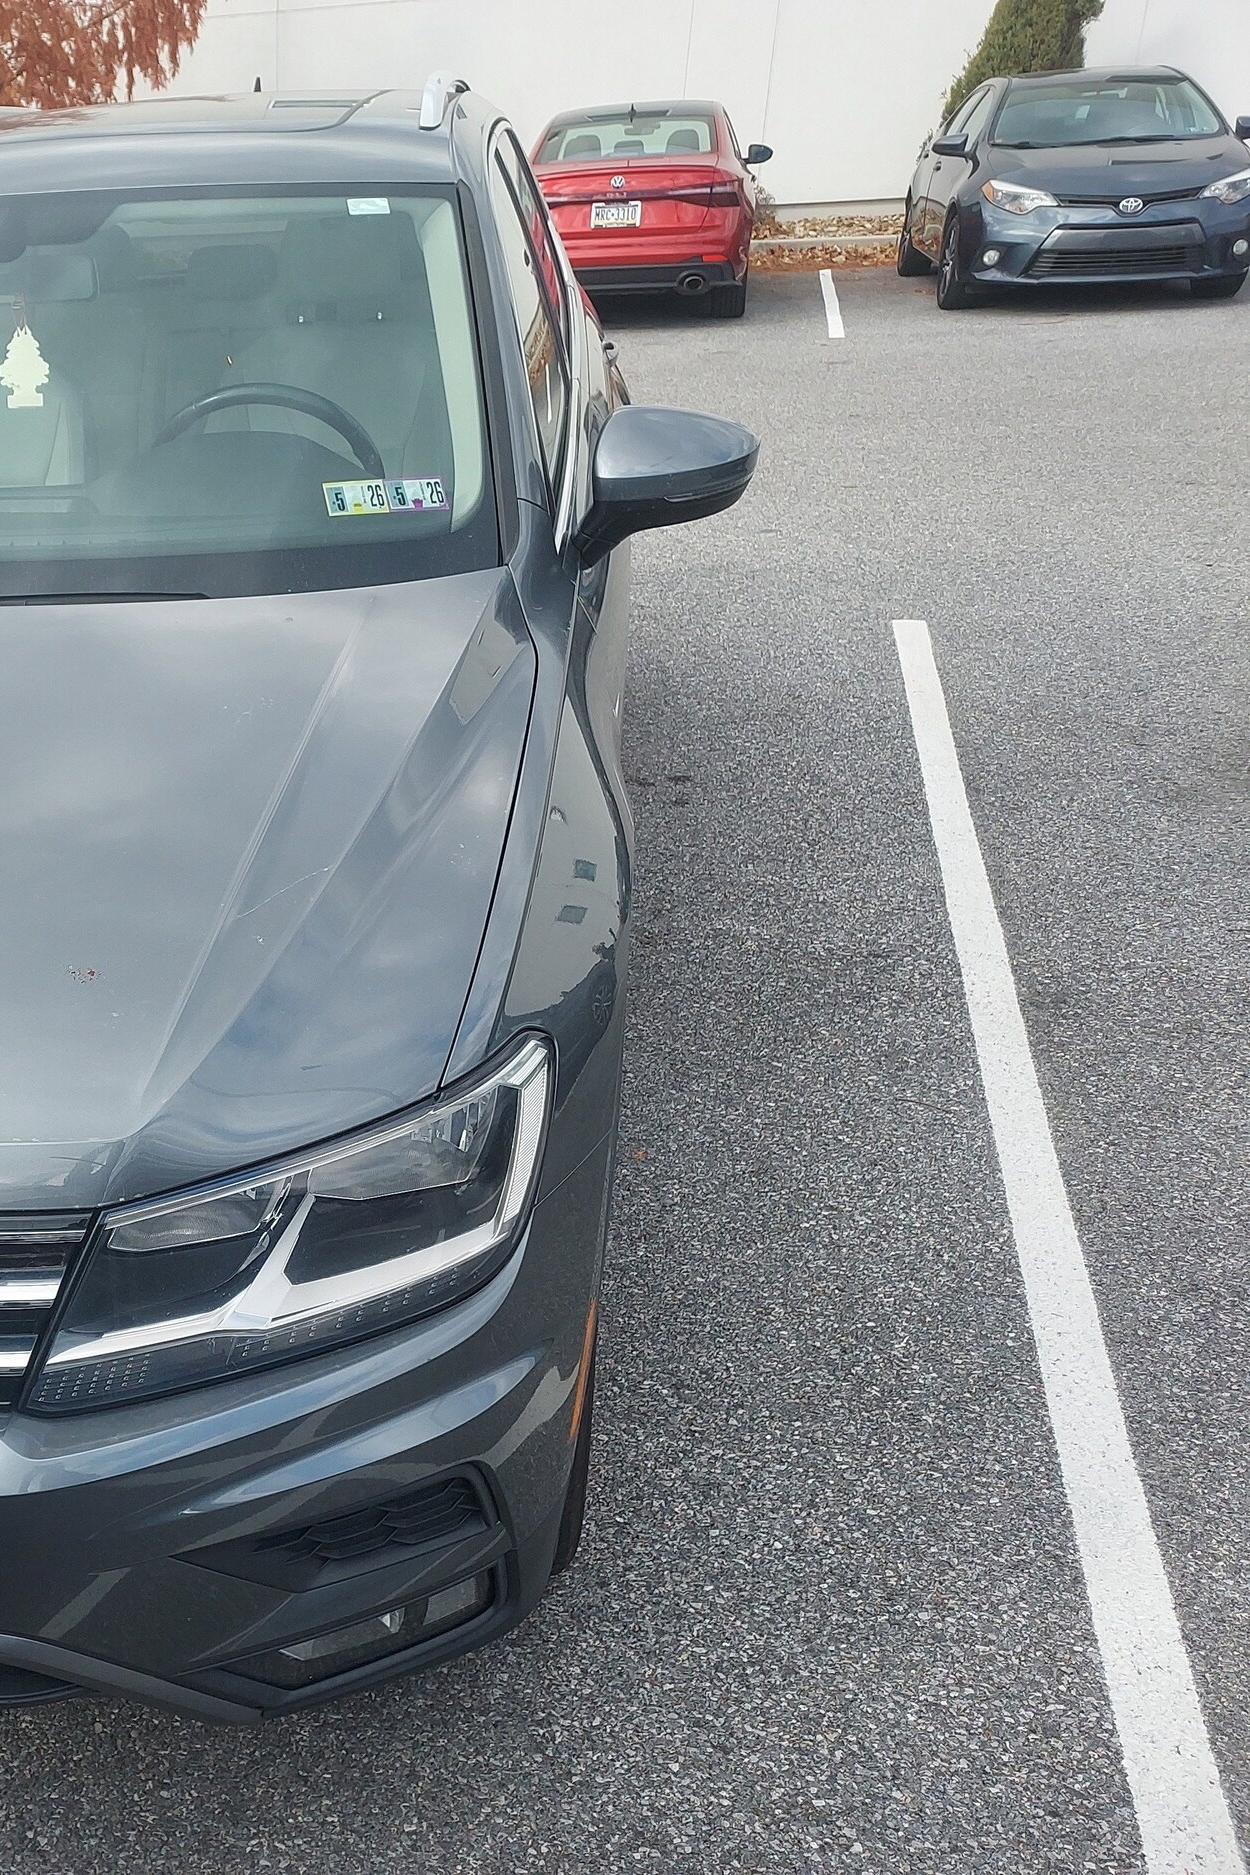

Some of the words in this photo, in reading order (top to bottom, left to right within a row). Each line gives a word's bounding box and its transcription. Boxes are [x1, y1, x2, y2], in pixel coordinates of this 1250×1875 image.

[334, 492, 346, 512] 5
[367, 484, 385, 507] 26
[394, 486, 406, 506] 5
[426, 481, 445, 504] 26
